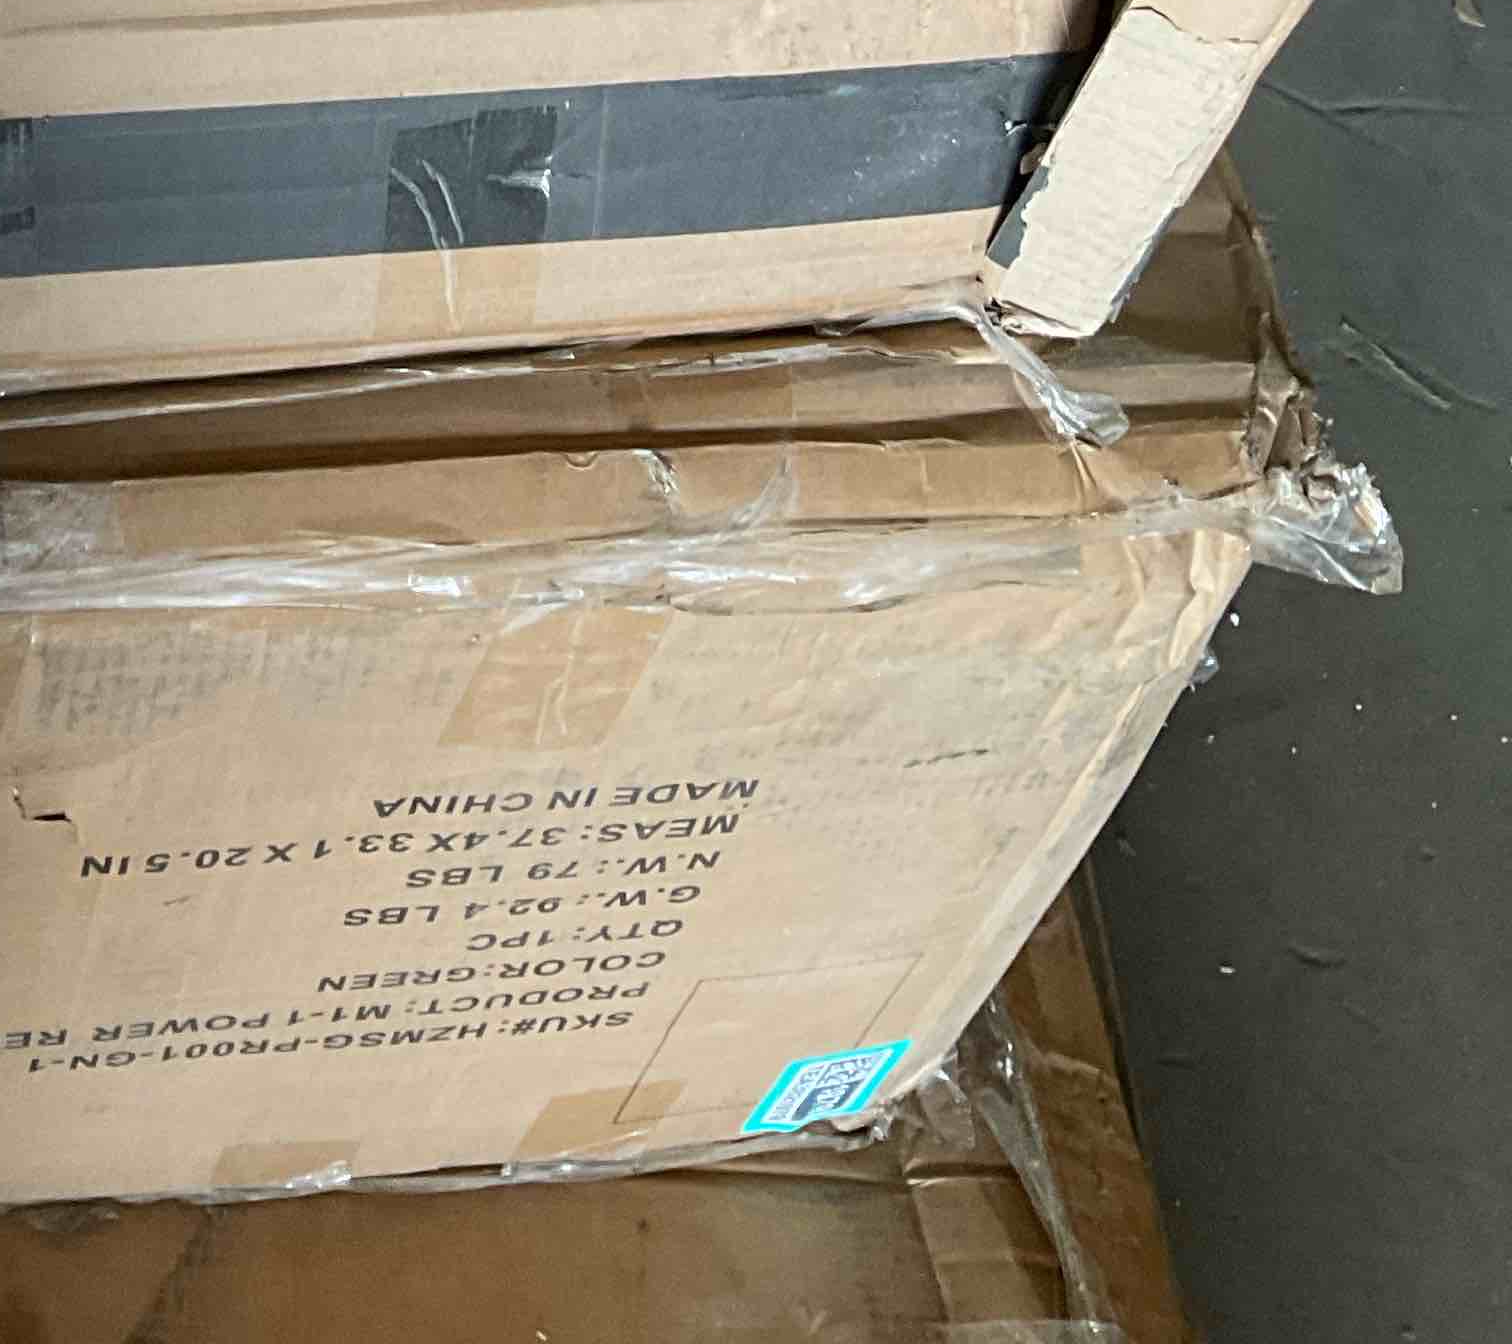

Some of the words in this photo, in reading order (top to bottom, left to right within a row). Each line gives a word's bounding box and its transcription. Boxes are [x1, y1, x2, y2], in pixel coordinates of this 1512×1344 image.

[371, 792, 534, 819] CHINA
[547, 787, 599, 811] IN
[608, 779, 760, 808] MADE
[580, 813, 741, 844] MEAS:
[143, 846, 253, 874] 20.5
[262, 842, 299, 865] X
[595, 850, 721, 876] N.W.:
[79, 855, 131, 878] IN
[405, 864, 504, 889] LBS
[526, 860, 579, 880] 79
[462, 897, 563, 920] 92.4
[576, 885, 702, 908] G.W.:
[342, 904, 441, 927] LBS
[465, 929, 555, 951] 1PC
[572, 919, 684, 942] QTY:
[403, 982, 651, 1016] PRODUCT:
[286, 1003, 392, 1026] M1-1
[497, 1009, 634, 1036] SKU#:
[91, 1012, 270, 1043] POWER
